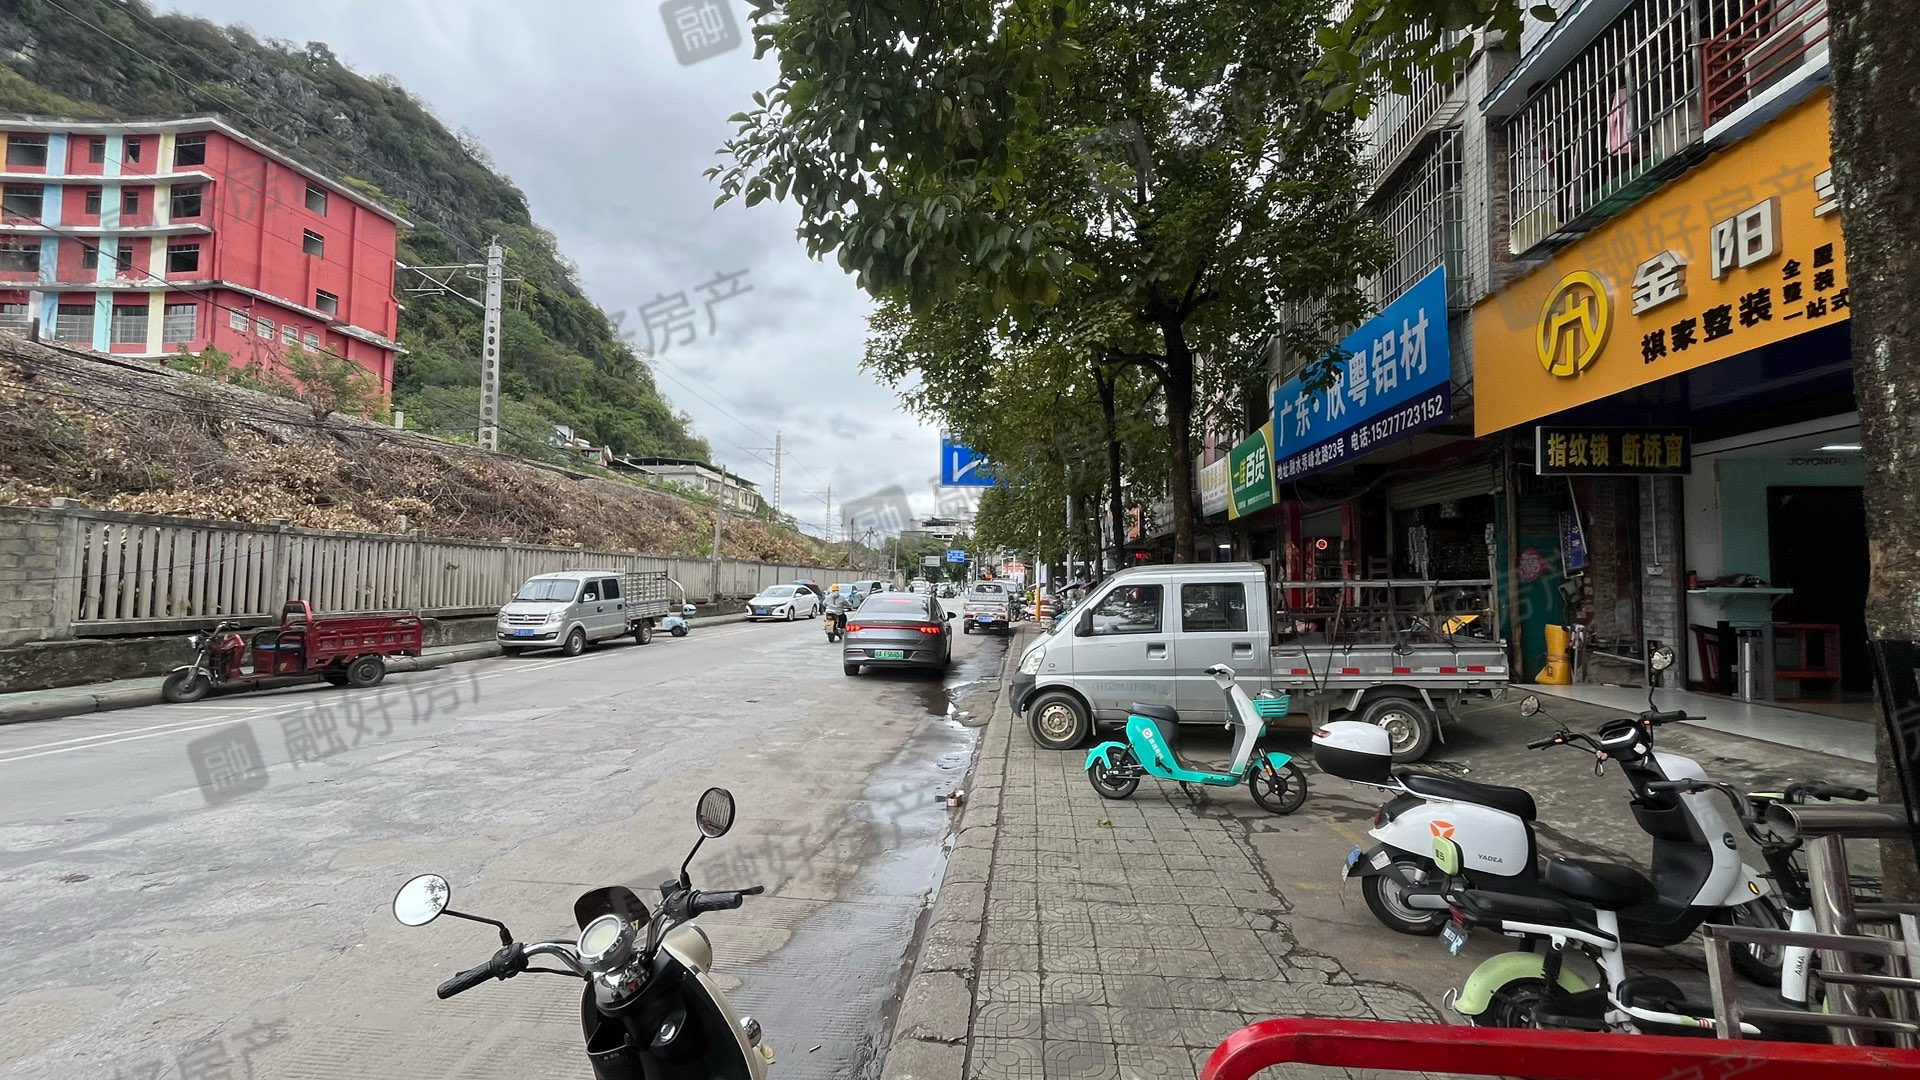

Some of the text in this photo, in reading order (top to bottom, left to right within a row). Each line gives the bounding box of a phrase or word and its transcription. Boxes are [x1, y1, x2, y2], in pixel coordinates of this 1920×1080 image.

[1547, 432, 1683, 467] 指纹锁 断桥窗
[1477, 853, 1503, 864] YADEA
